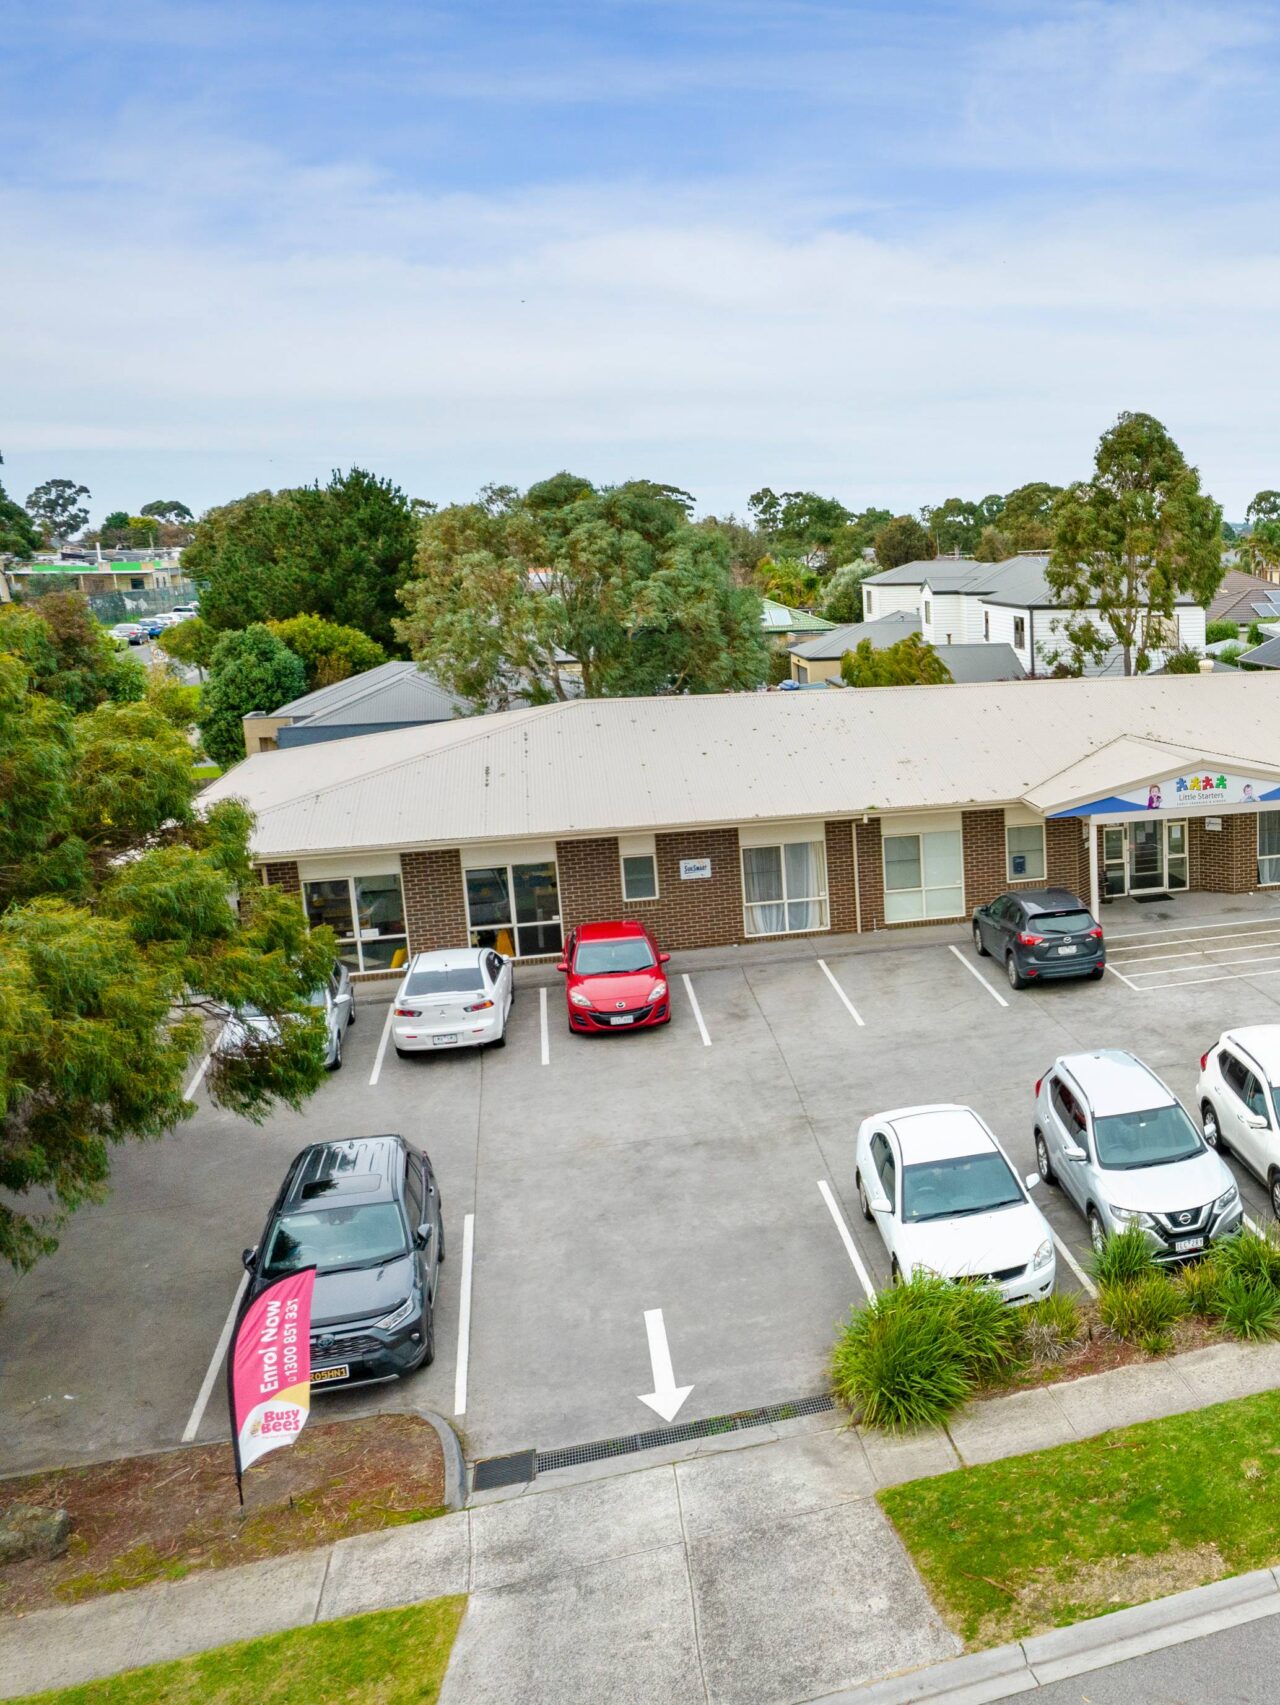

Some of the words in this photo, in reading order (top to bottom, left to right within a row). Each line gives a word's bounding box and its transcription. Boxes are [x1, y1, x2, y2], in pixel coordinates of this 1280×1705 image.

[1179, 793, 1196, 801] Little
[1198, 792, 1224, 800] Starters
[284, 1298, 298, 1320] 331
[260, 1301, 281, 1343] Now
[283, 1322, 298, 1344] 851
[258, 1346, 279, 1393] Enrol
[283, 1346, 298, 1376] 1300
[261, 1420, 300, 1434] Bees
[264, 1409, 300, 1423] Busy
